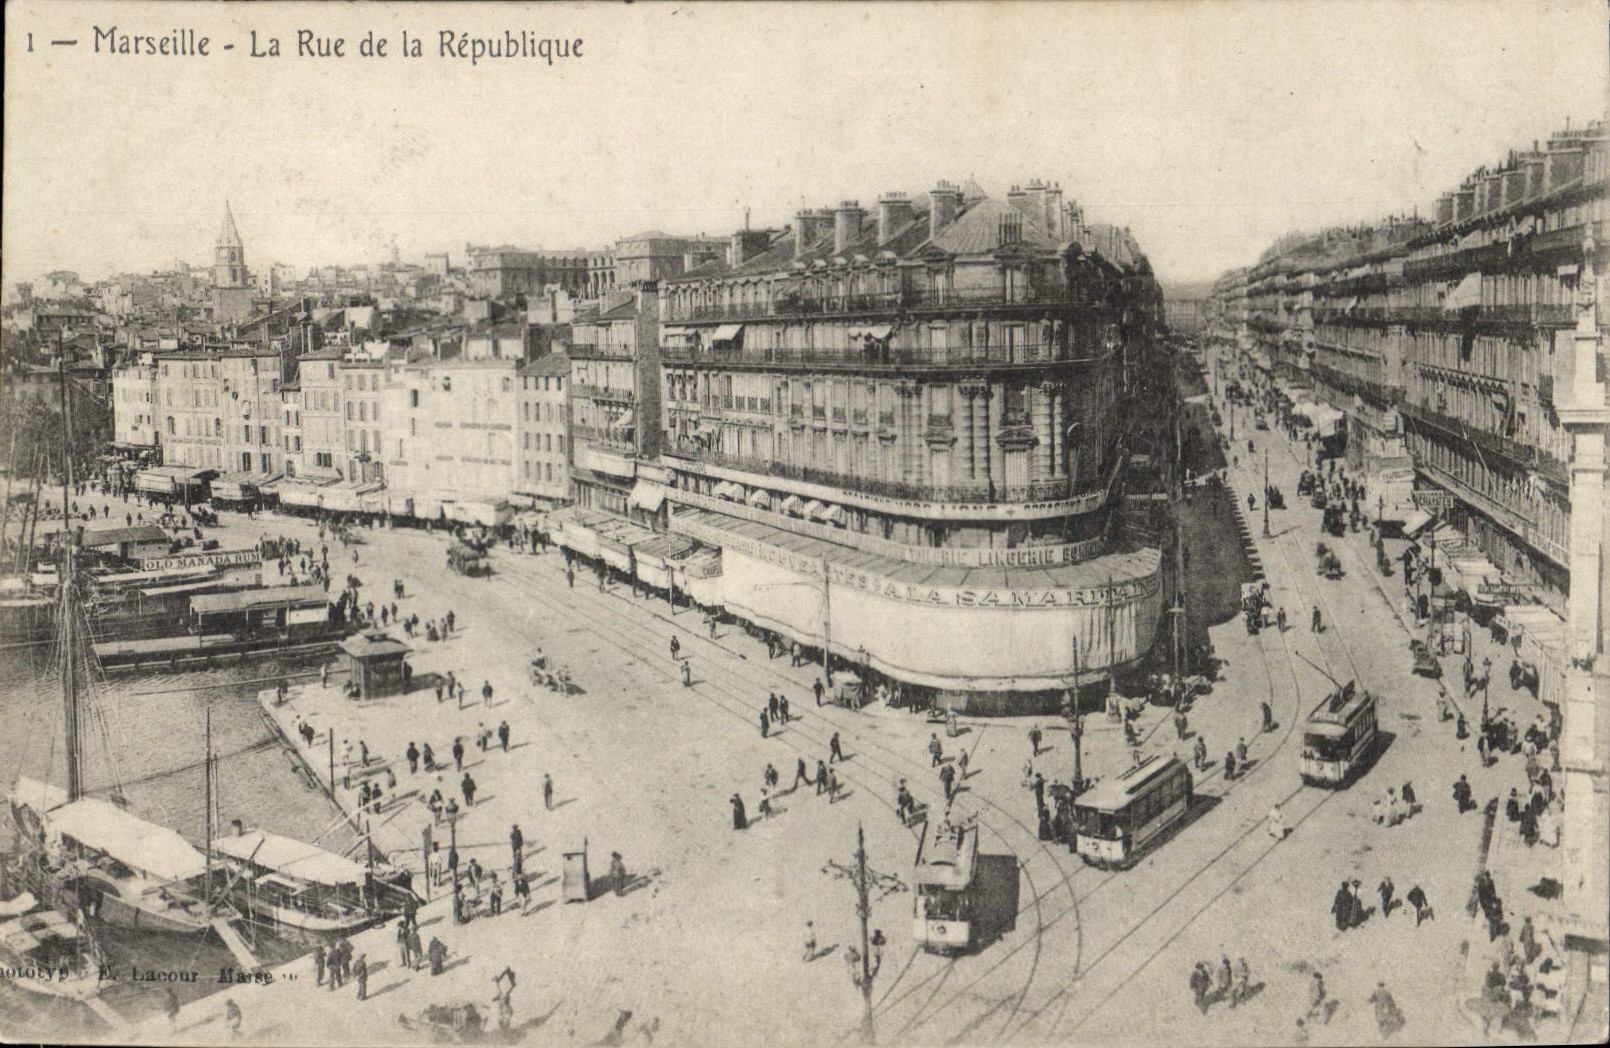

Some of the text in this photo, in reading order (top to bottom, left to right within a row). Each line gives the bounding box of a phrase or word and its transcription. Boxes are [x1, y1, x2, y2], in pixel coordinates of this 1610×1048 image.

[146, 559, 173, 570] OLD
[235, 553, 260, 564] RUM
[978, 548, 1054, 566] LINGERIE
[906, 585, 946, 602] LA
